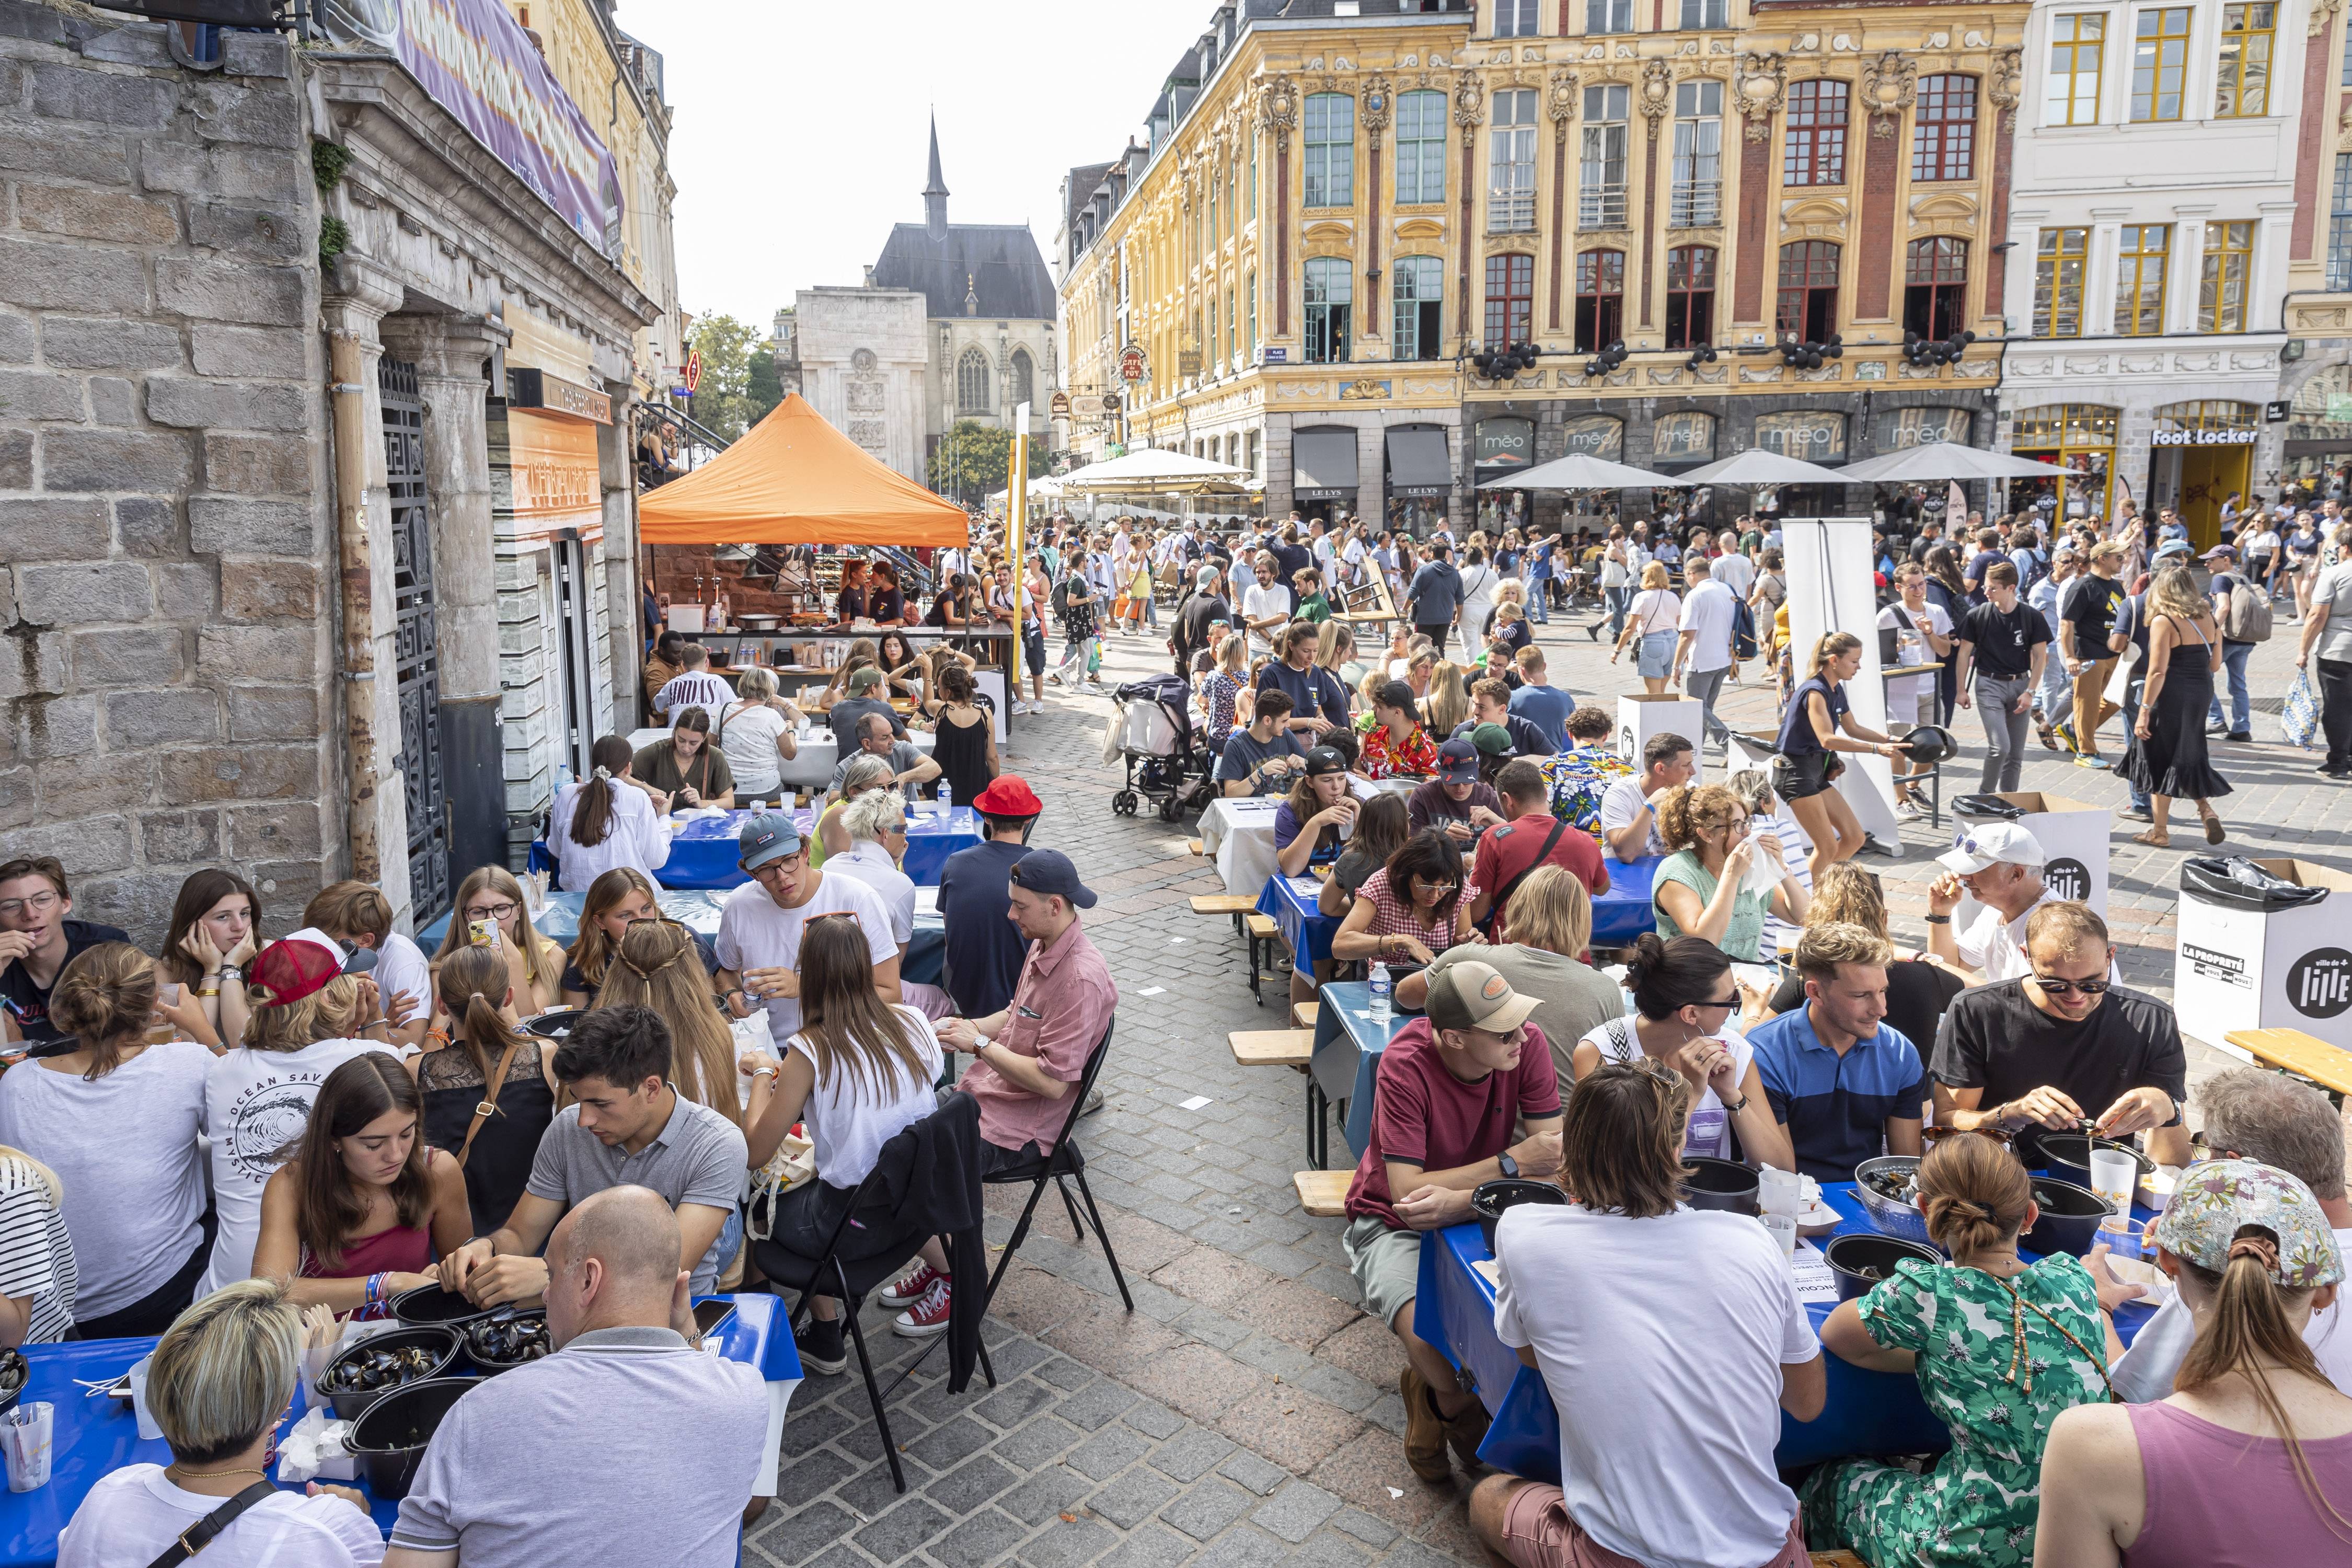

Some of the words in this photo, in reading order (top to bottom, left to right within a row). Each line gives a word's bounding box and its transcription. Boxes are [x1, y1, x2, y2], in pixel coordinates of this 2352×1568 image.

[856, 303, 900, 315] LILLOIS
[1119, 346, 1146, 358] BRASSERIE
[593, 398, 607, 420] NORD
[2152, 430, 2192, 445] Foot
[2196, 428, 2258, 444] Locker
[669, 679, 717, 706] ADIDAS
[1496, 828, 1512, 837] OXBOW
[2183, 946, 2195, 957] LA
[2195, 949, 2244, 971] PROPRETÉ
[2206, 969, 2220, 977] VOUS
[230, 1076, 277, 1116] OCEAN
[289, 1073, 325, 1083] SAV
[225, 1137, 263, 1183] MYSTIC
